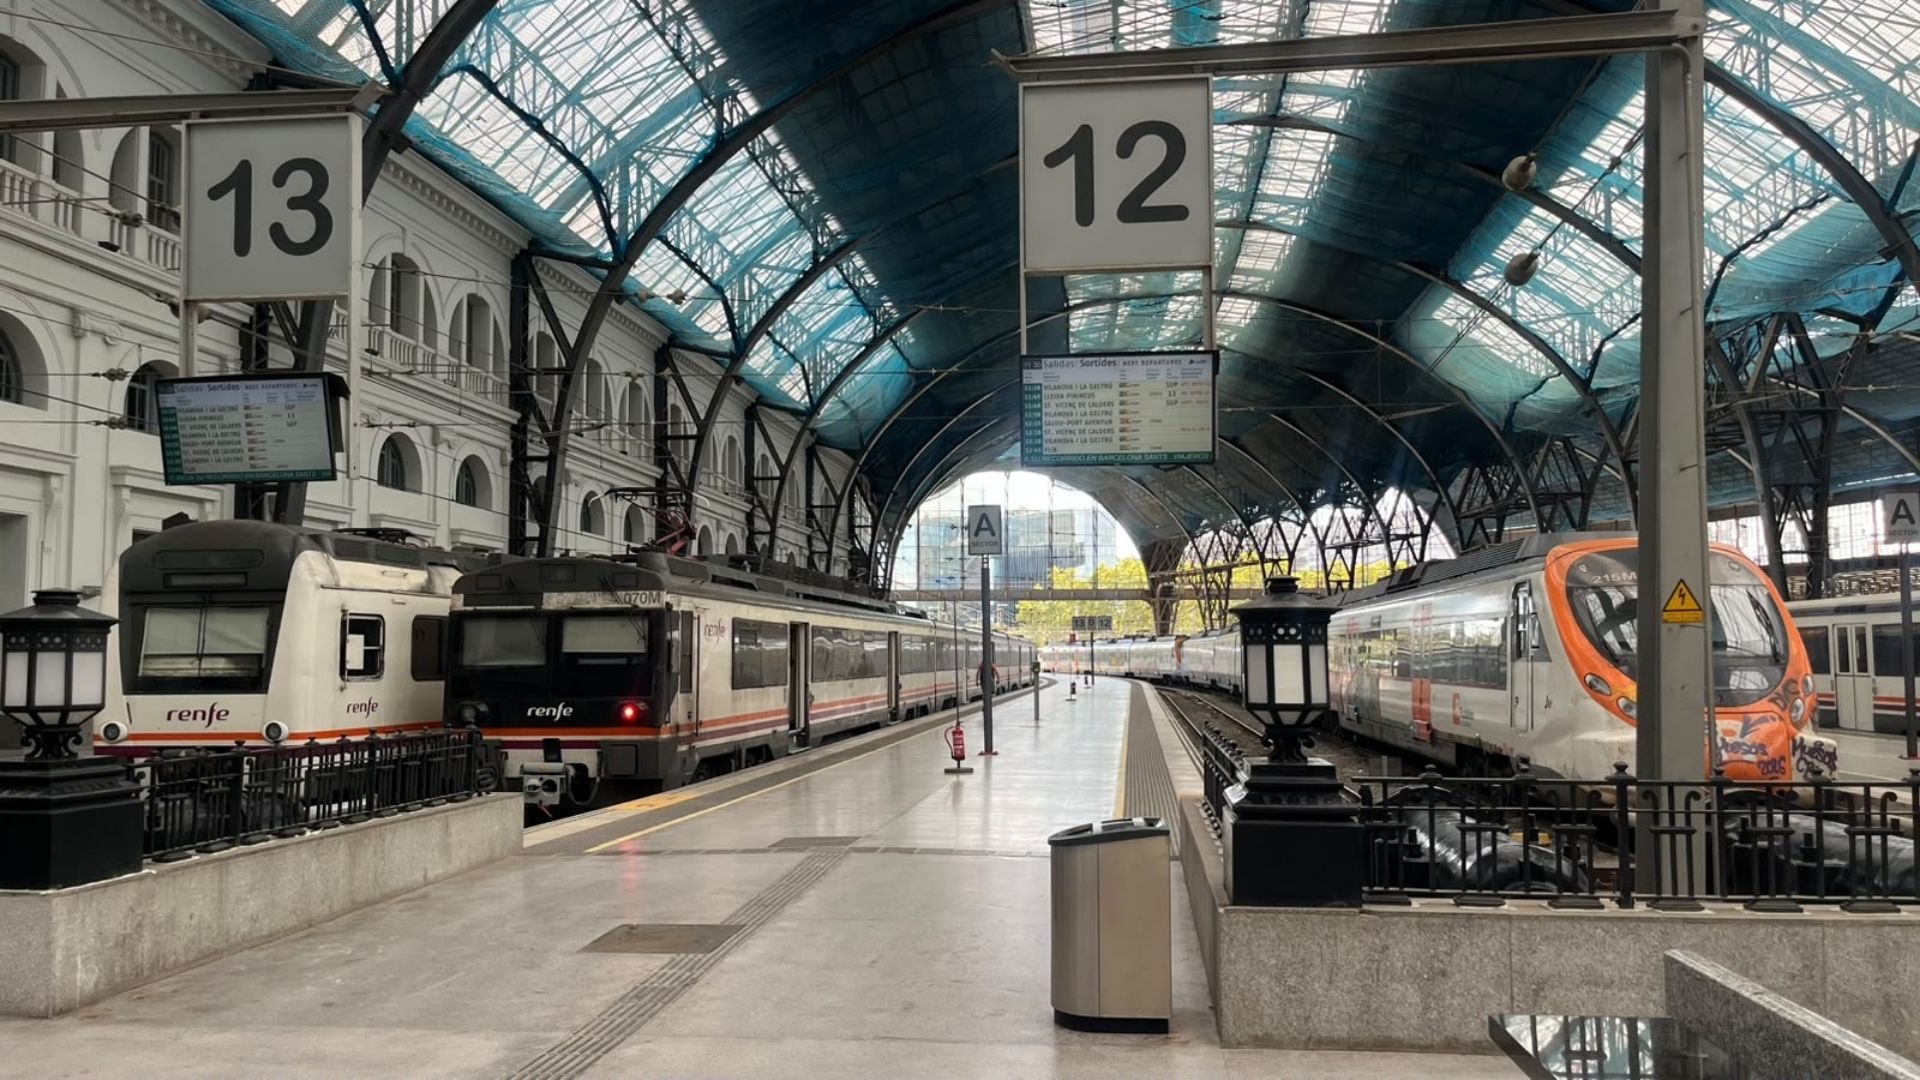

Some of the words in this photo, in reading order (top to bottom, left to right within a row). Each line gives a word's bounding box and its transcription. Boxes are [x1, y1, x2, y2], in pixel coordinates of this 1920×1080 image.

[1043, 120, 1189, 227] 12
[207, 157, 333, 257] 13
[1044, 360, 1074, 369] Salidas
[1080, 359, 1117, 368] Sortides
[207, 383, 240, 391] Sortides
[1890, 499, 1915, 525] A
[974, 512, 996, 537] A
[1592, 571, 1638, 584] 215M
[166, 702, 230, 728] renfe
[346, 696, 379, 718] renfe
[527, 702, 573, 721] renfe
